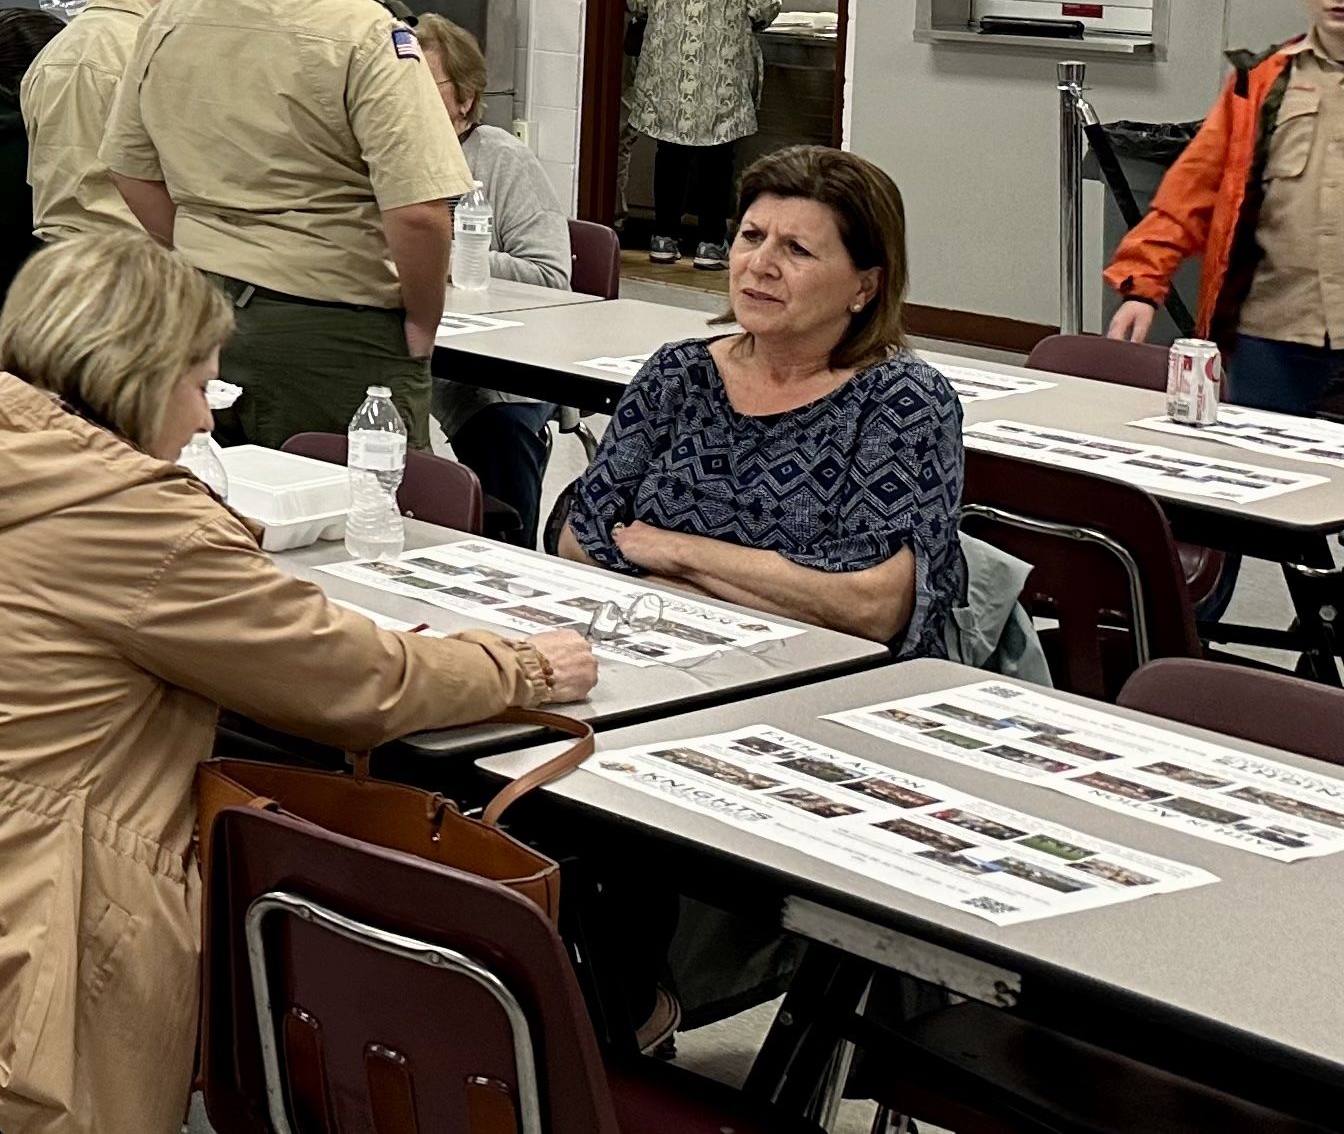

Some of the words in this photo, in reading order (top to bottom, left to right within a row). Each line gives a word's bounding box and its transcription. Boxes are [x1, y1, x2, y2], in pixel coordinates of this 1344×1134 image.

[757, 731, 822, 751] FAITH
[841, 760, 930, 789] ACTION
[639, 771, 777, 820] KNIGHTS
